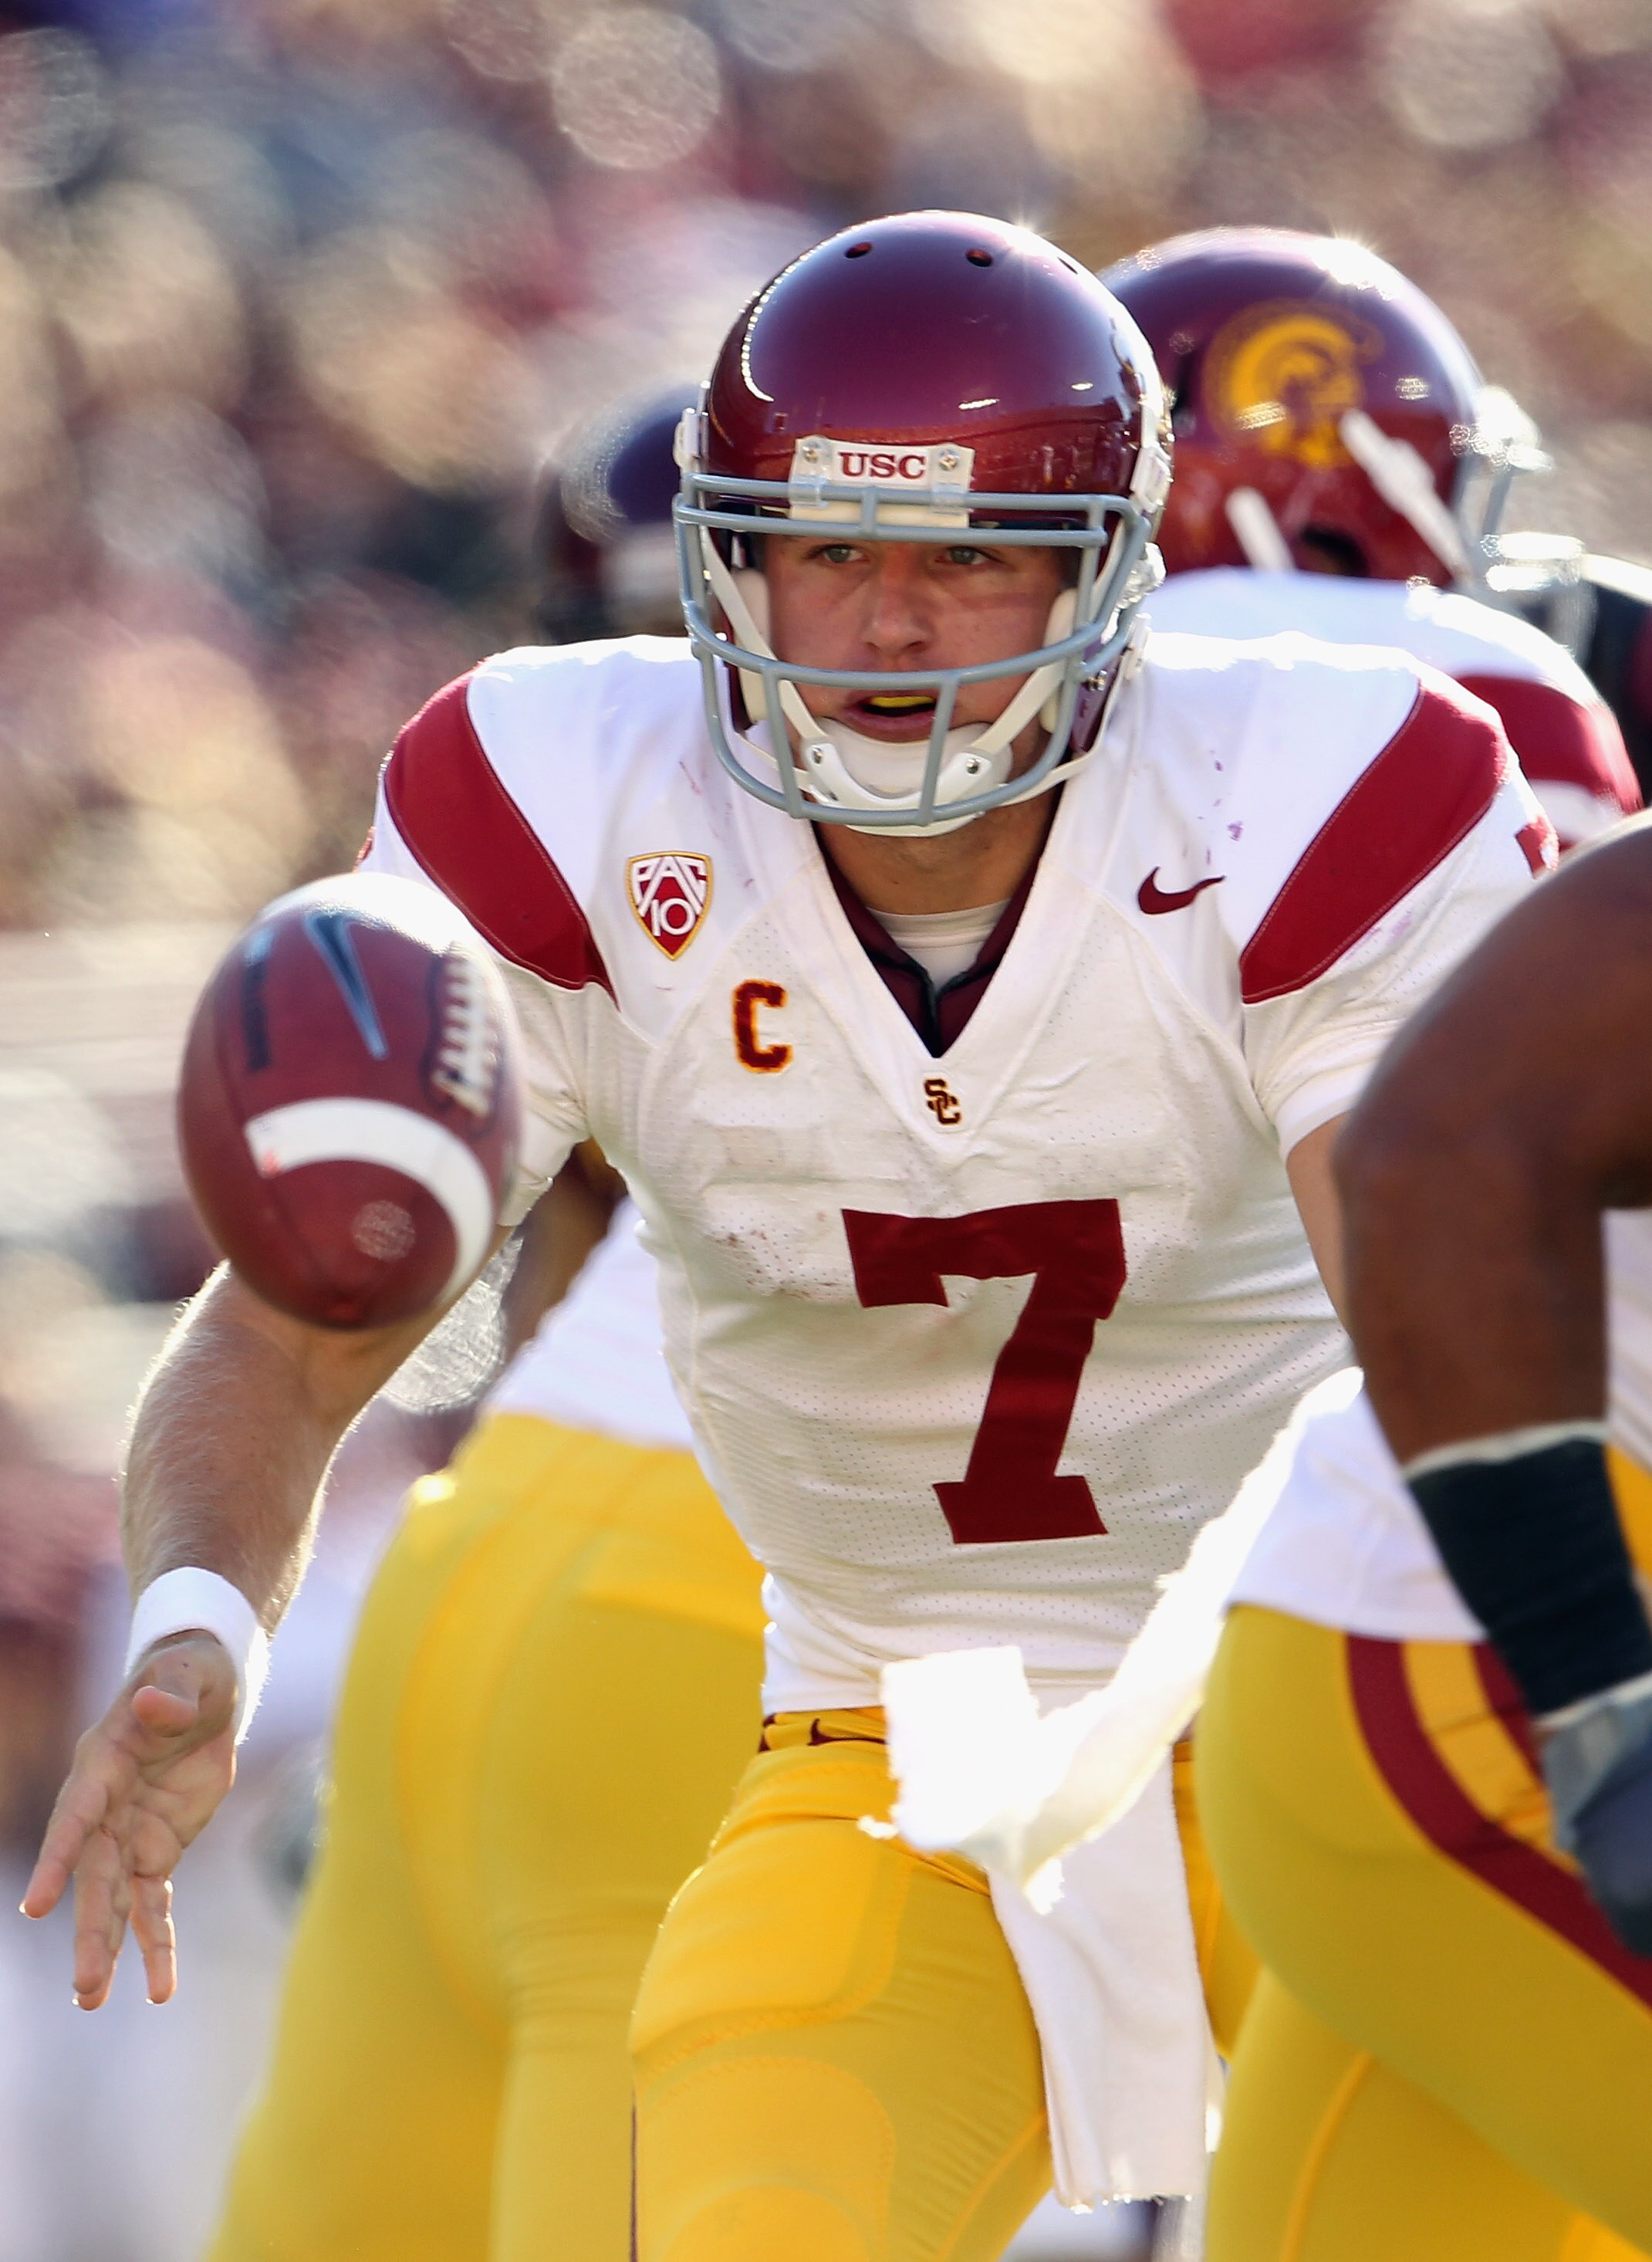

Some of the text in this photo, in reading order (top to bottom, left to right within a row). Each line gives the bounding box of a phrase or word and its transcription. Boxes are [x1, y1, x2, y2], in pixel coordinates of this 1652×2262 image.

[839, 451, 927, 479] USC
[631, 855, 708, 918] PAC
[650, 898, 695, 937] 10
[732, 979, 793, 1074] C
[924, 1078, 961, 1125] SC
[841, 1198, 1127, 1544] 7
